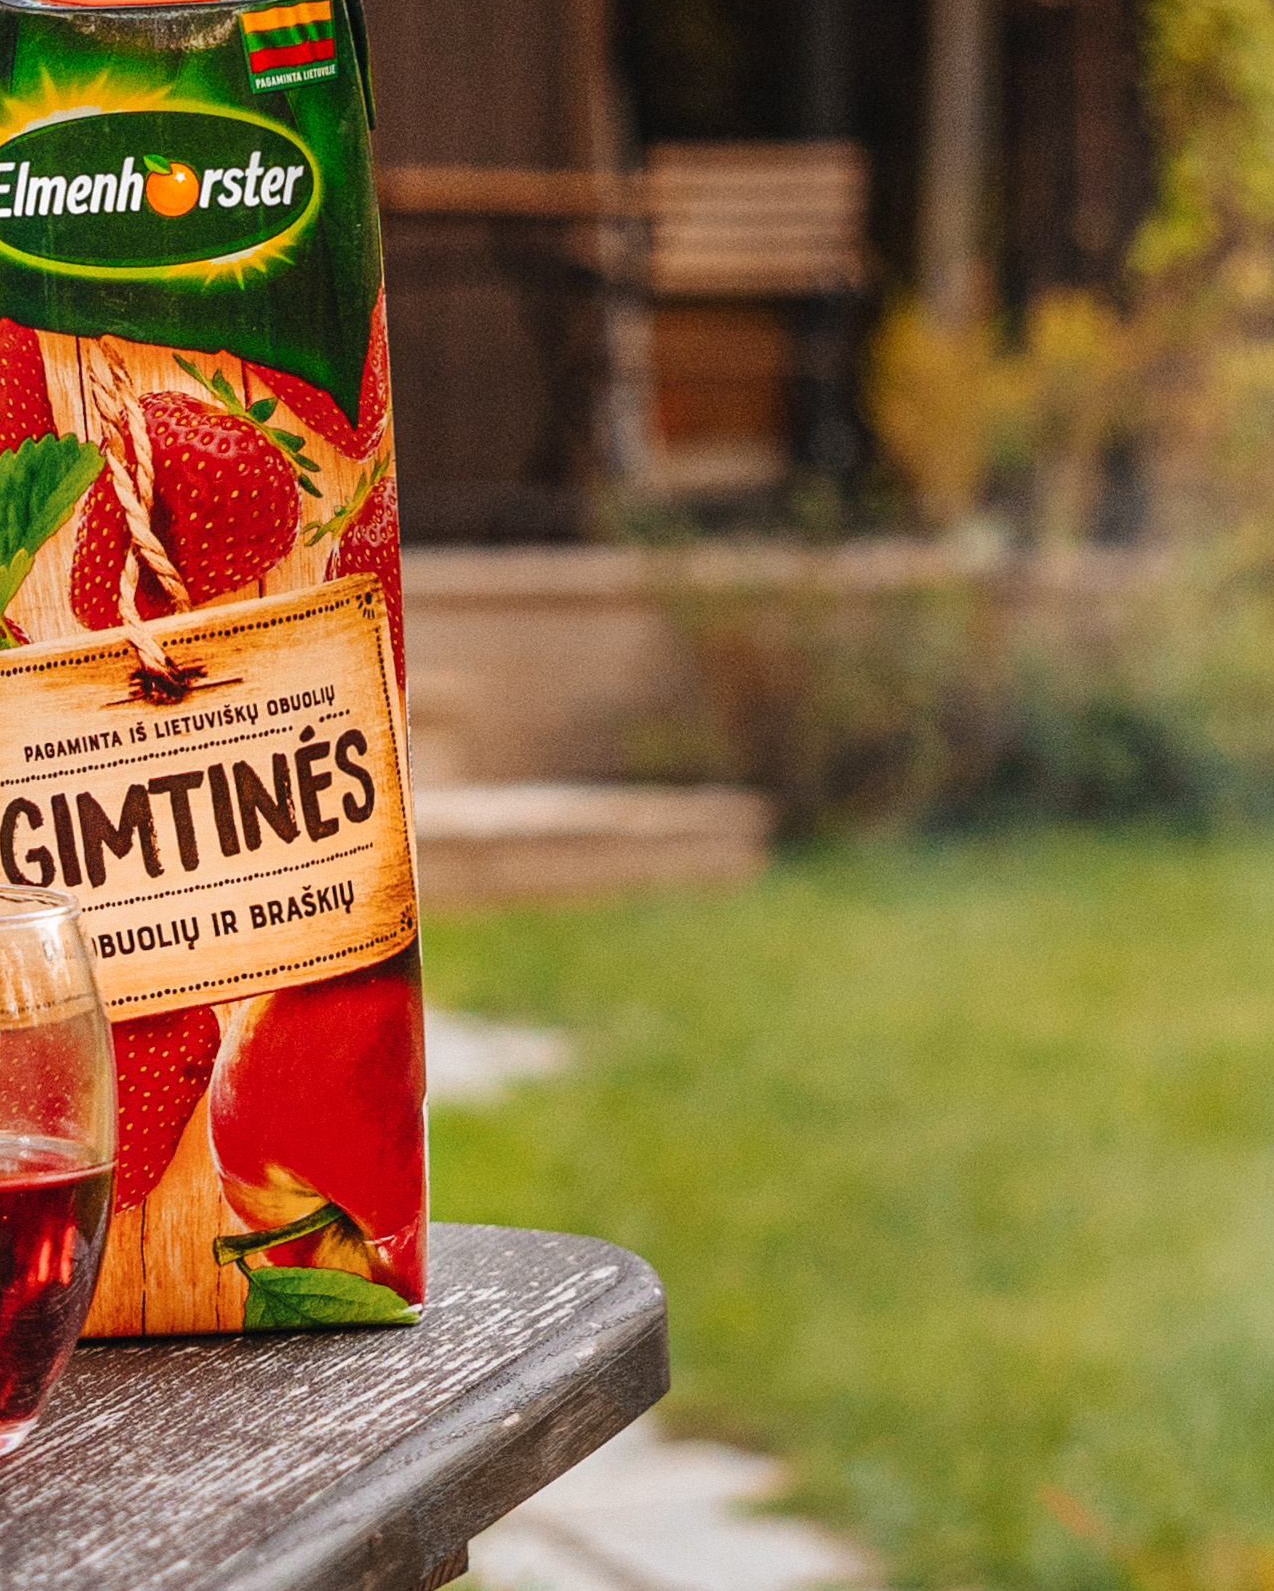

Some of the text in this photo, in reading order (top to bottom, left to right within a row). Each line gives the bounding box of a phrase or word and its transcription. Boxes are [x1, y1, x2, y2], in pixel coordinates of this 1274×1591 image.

[255, 71, 302, 89] PAGAMINTA
[23, 685, 336, 762] PAGAMINTA IŠ LIETUVIŠKŲ OBUOLIŲ
[0, 725, 376, 888] GIMTINĖS
[91, 879, 356, 959] BUOLIŲ IR BRAŠKIŲ
